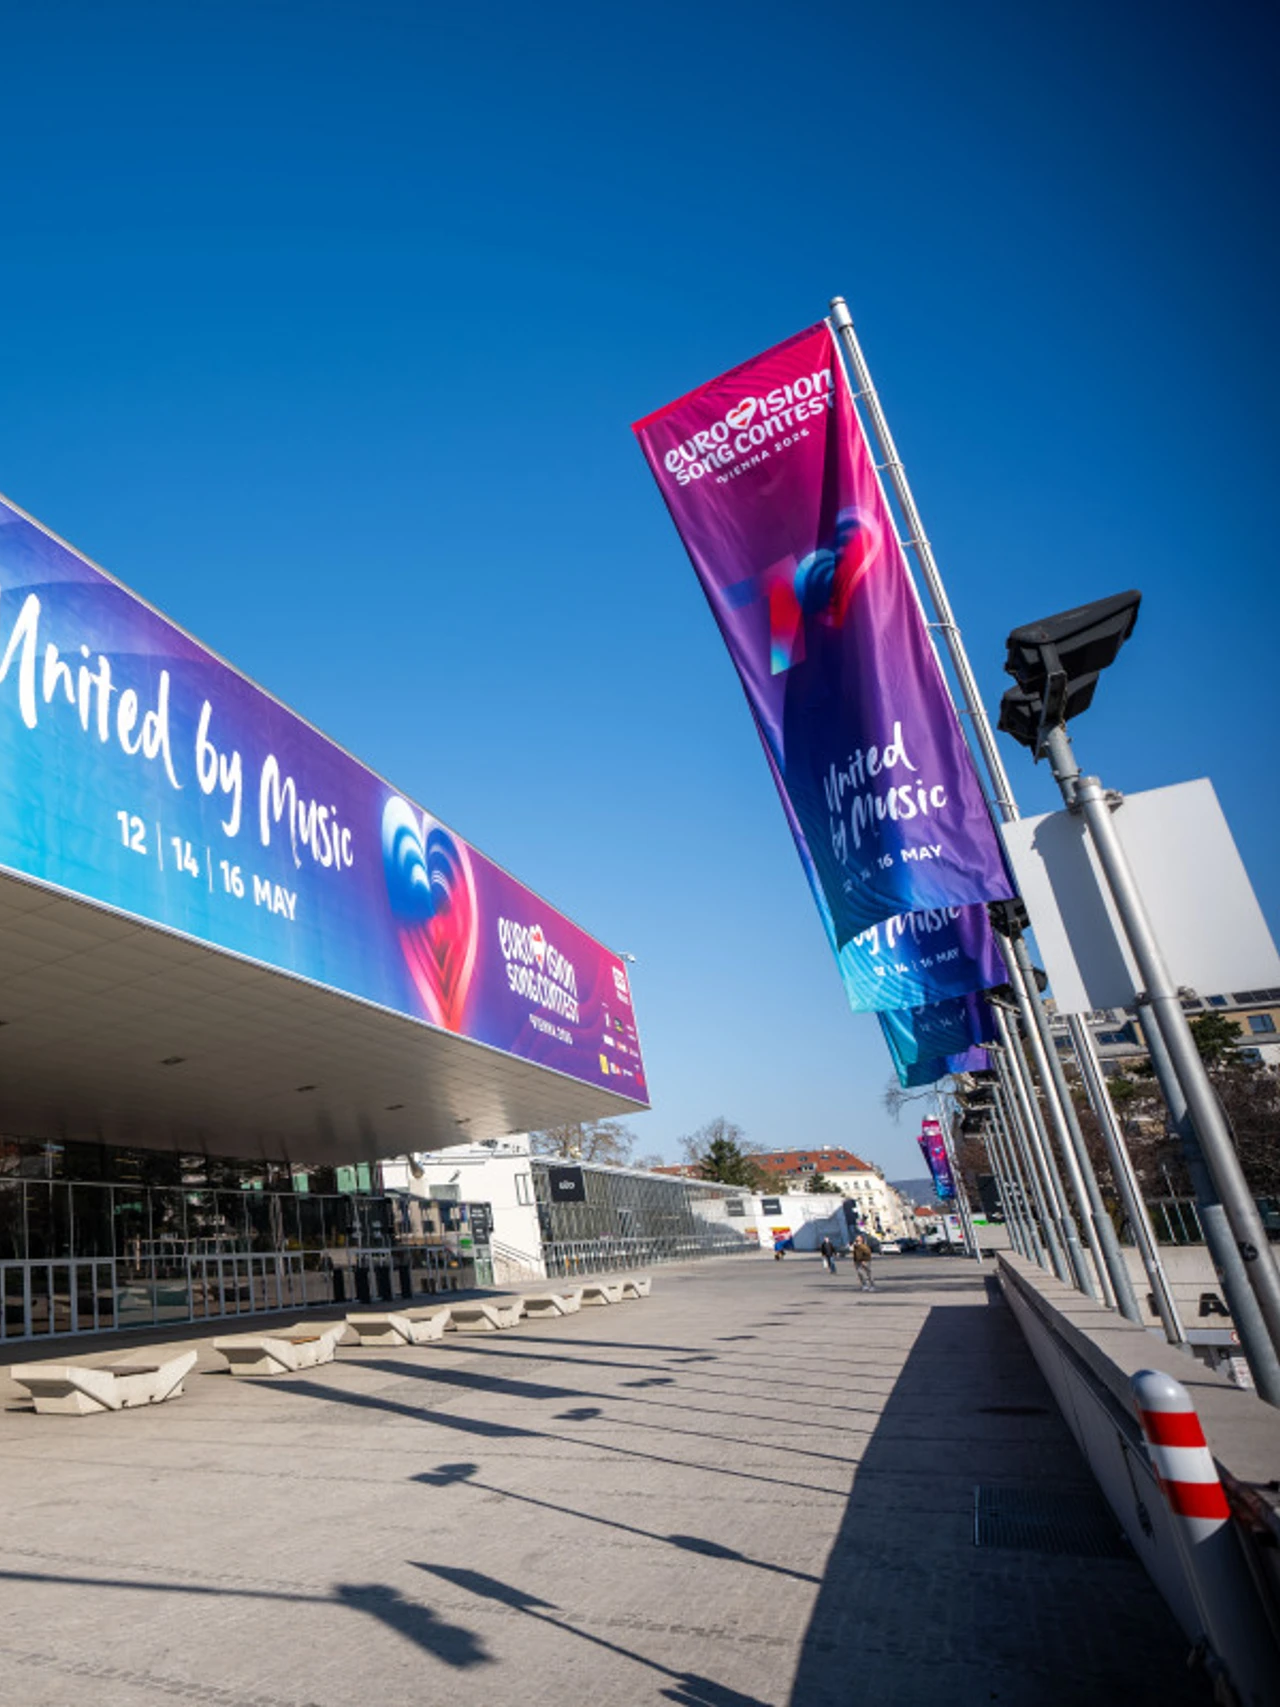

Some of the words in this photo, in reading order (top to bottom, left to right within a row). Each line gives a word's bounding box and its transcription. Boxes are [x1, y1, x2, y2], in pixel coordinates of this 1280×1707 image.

[715, 450, 771, 484] VIENNA
[774, 427, 810, 452] 2026
[195, 699, 242, 838] by
[259, 754, 354, 869] Music
[823, 721, 918, 813] United
[851, 780, 948, 851] Music
[117, 810, 148, 855] 12
[171, 836, 200, 878] 14
[220, 859, 245, 899] 16
[252, 873, 298, 921] MAY
[877, 853, 894, 870] 16
[900, 844, 942, 863] MAY
